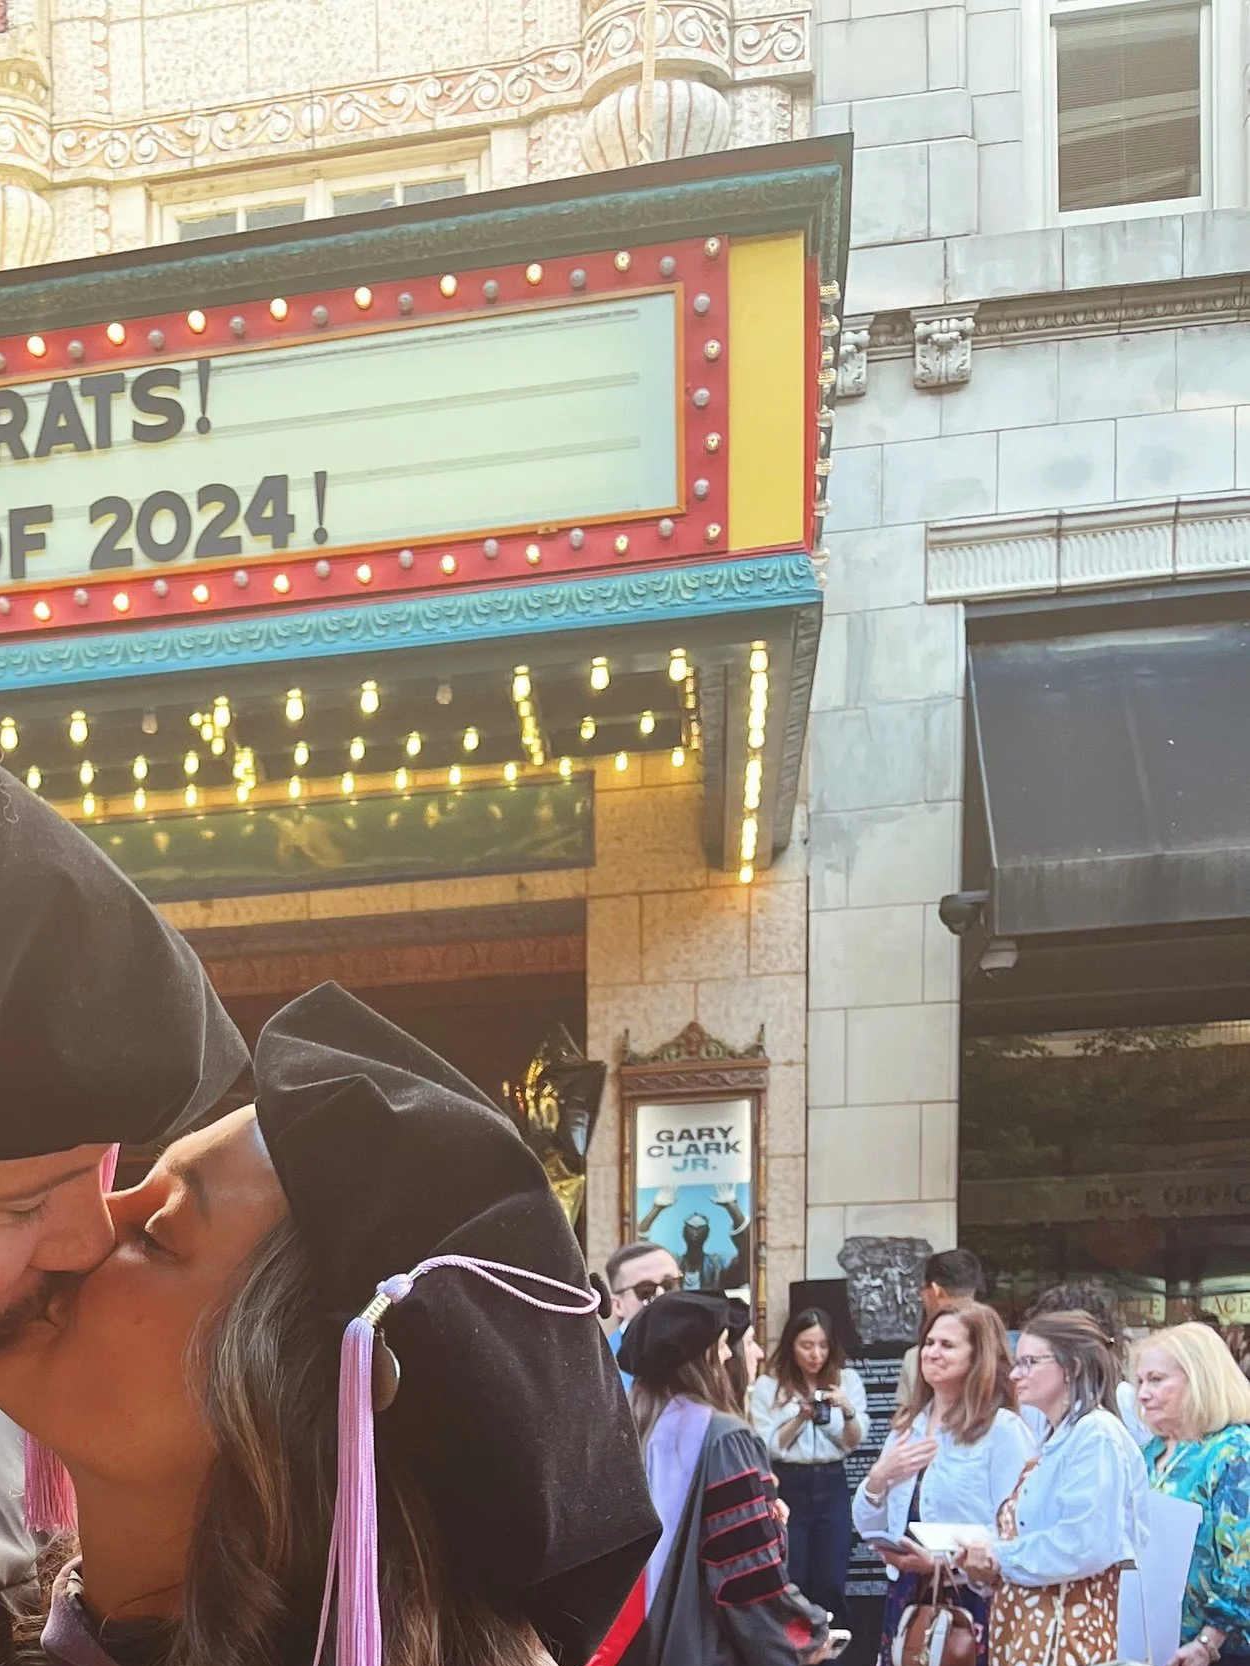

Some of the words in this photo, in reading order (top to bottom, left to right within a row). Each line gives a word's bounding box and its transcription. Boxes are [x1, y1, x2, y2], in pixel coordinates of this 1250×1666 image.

[89, 470, 328, 570] 2024!
[655, 1126, 734, 1143] GARY
[646, 1140, 742, 1159] CLARK
[671, 1157, 718, 1172] JR.
